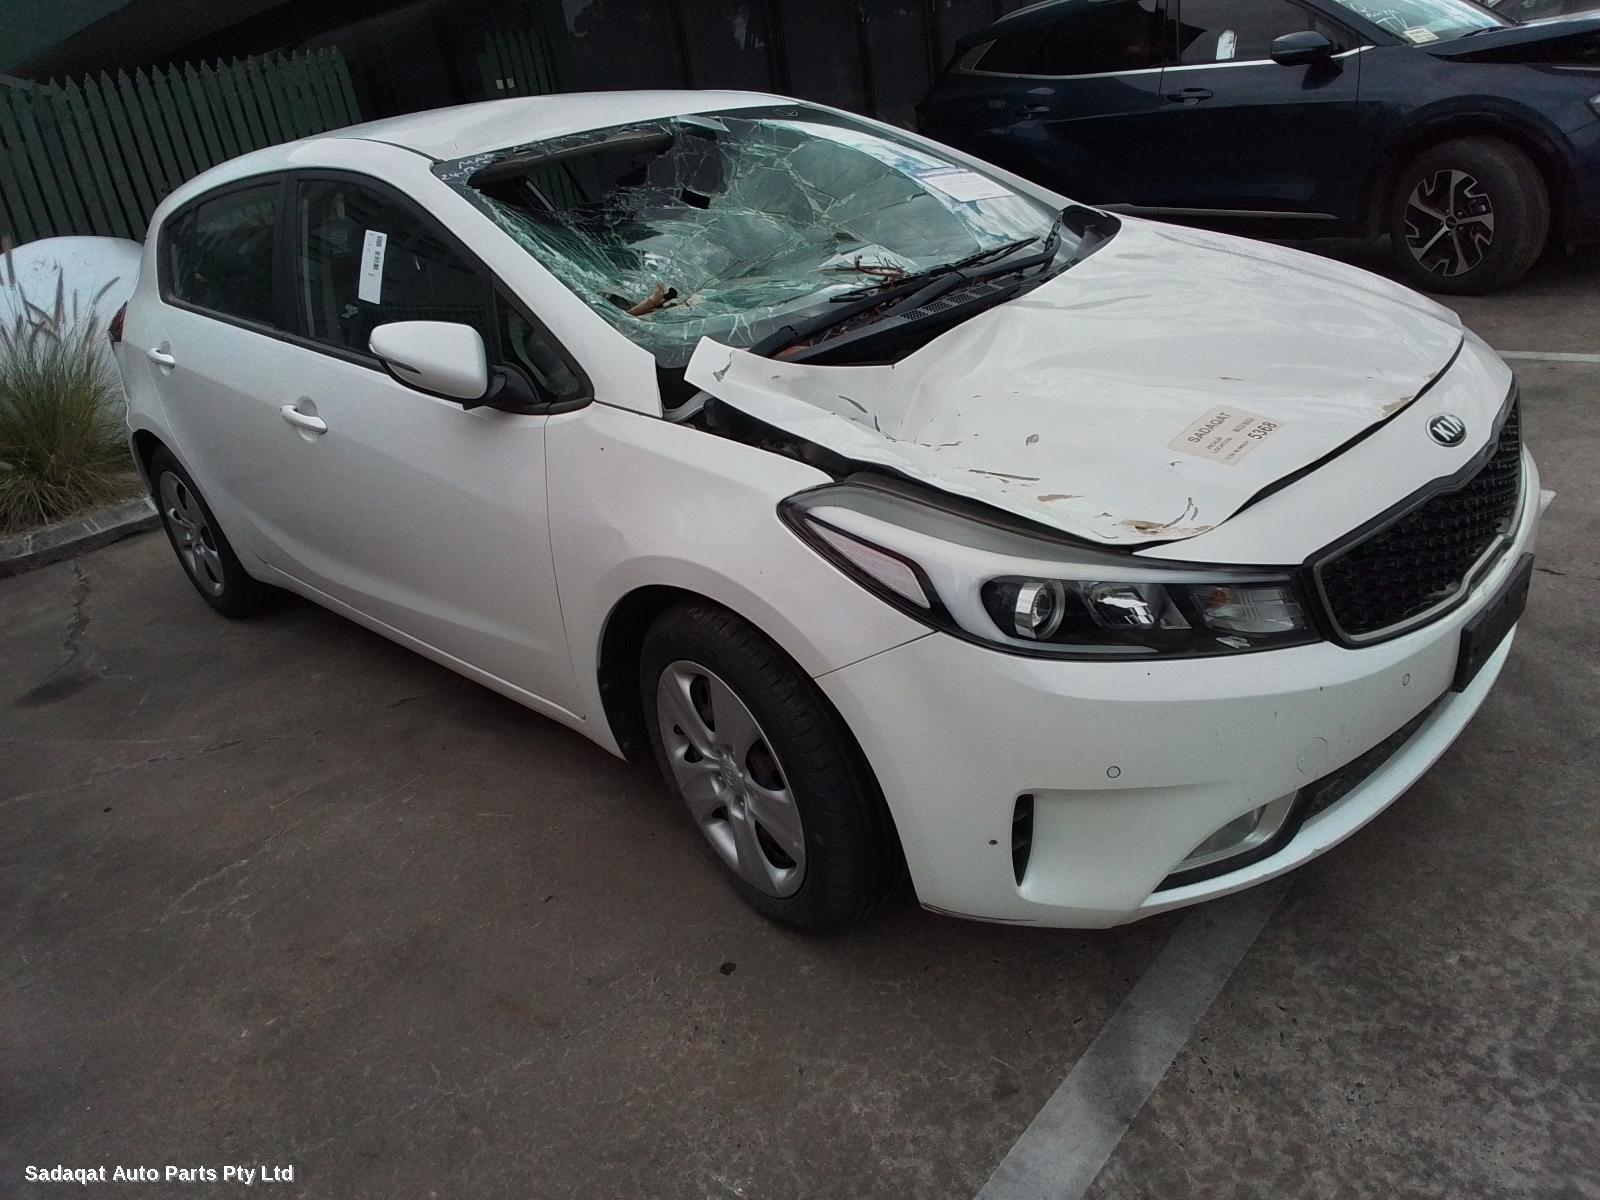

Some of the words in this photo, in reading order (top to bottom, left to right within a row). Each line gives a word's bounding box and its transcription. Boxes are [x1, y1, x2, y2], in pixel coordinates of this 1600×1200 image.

[1187, 411, 1233, 443] SADAQAT
[1247, 421, 1278, 441] 5368
[1432, 416, 1462, 441] KIA
